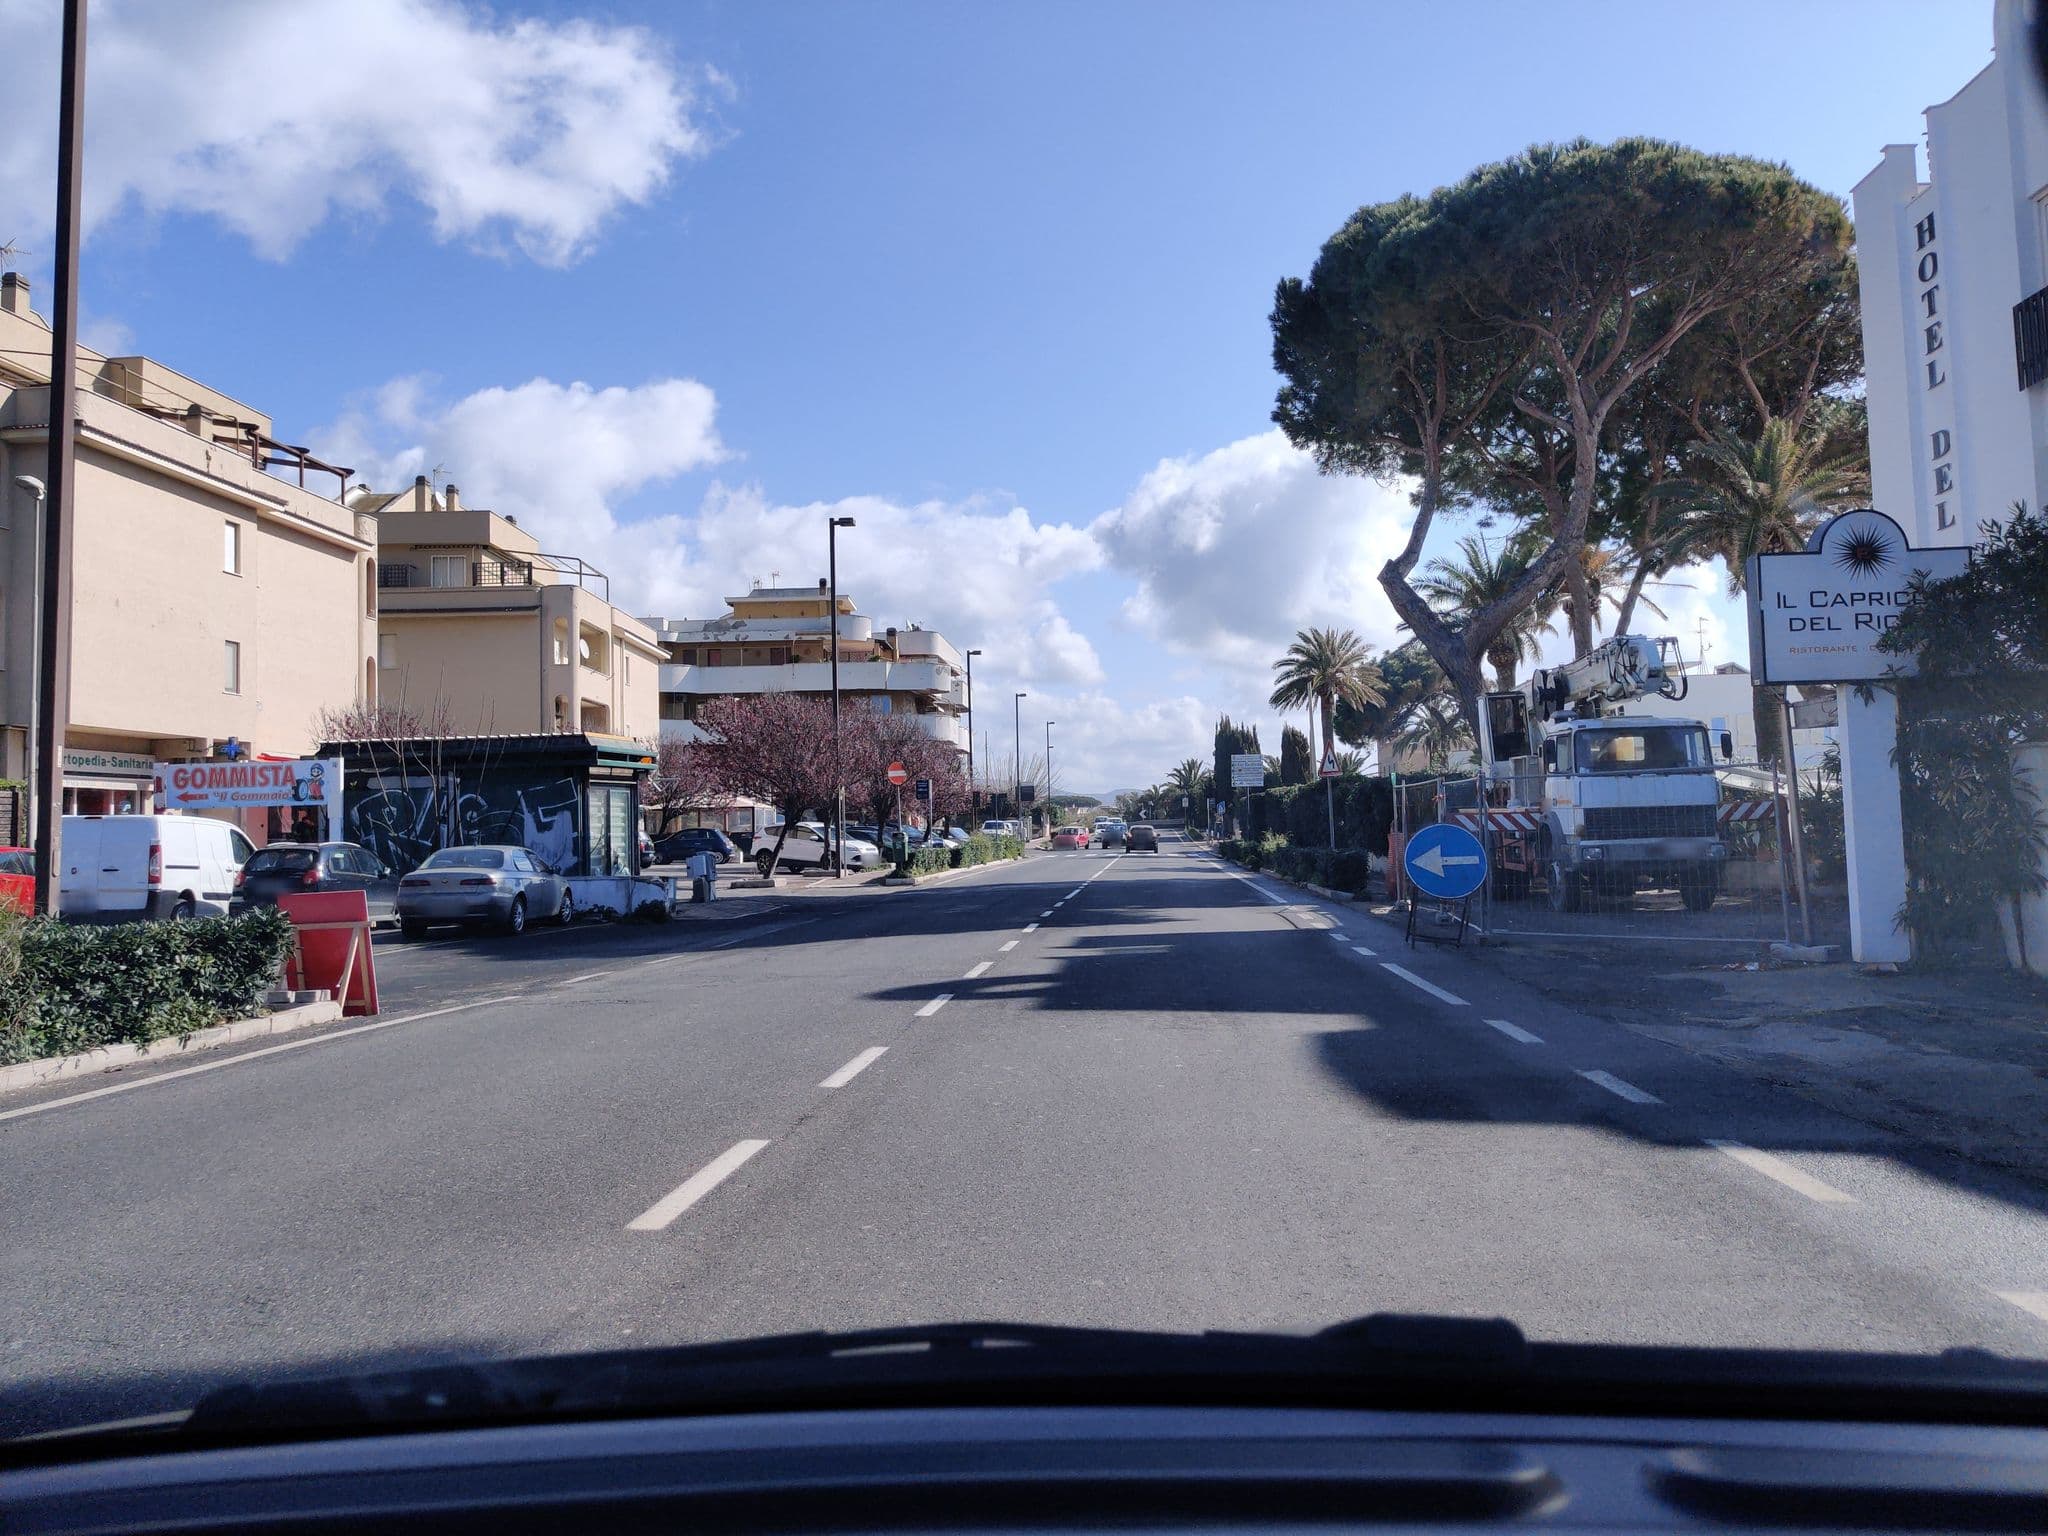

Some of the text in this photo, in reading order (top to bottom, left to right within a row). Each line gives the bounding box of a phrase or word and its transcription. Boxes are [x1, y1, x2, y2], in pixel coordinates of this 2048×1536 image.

[1914, 211, 1956, 532] HOTEL DEL
[1776, 591, 1798, 609] IL
[1789, 616, 1842, 632] DEL
[1789, 645, 1857, 655] RISTORANTE
[172, 764, 297, 789] GOMMISTA
